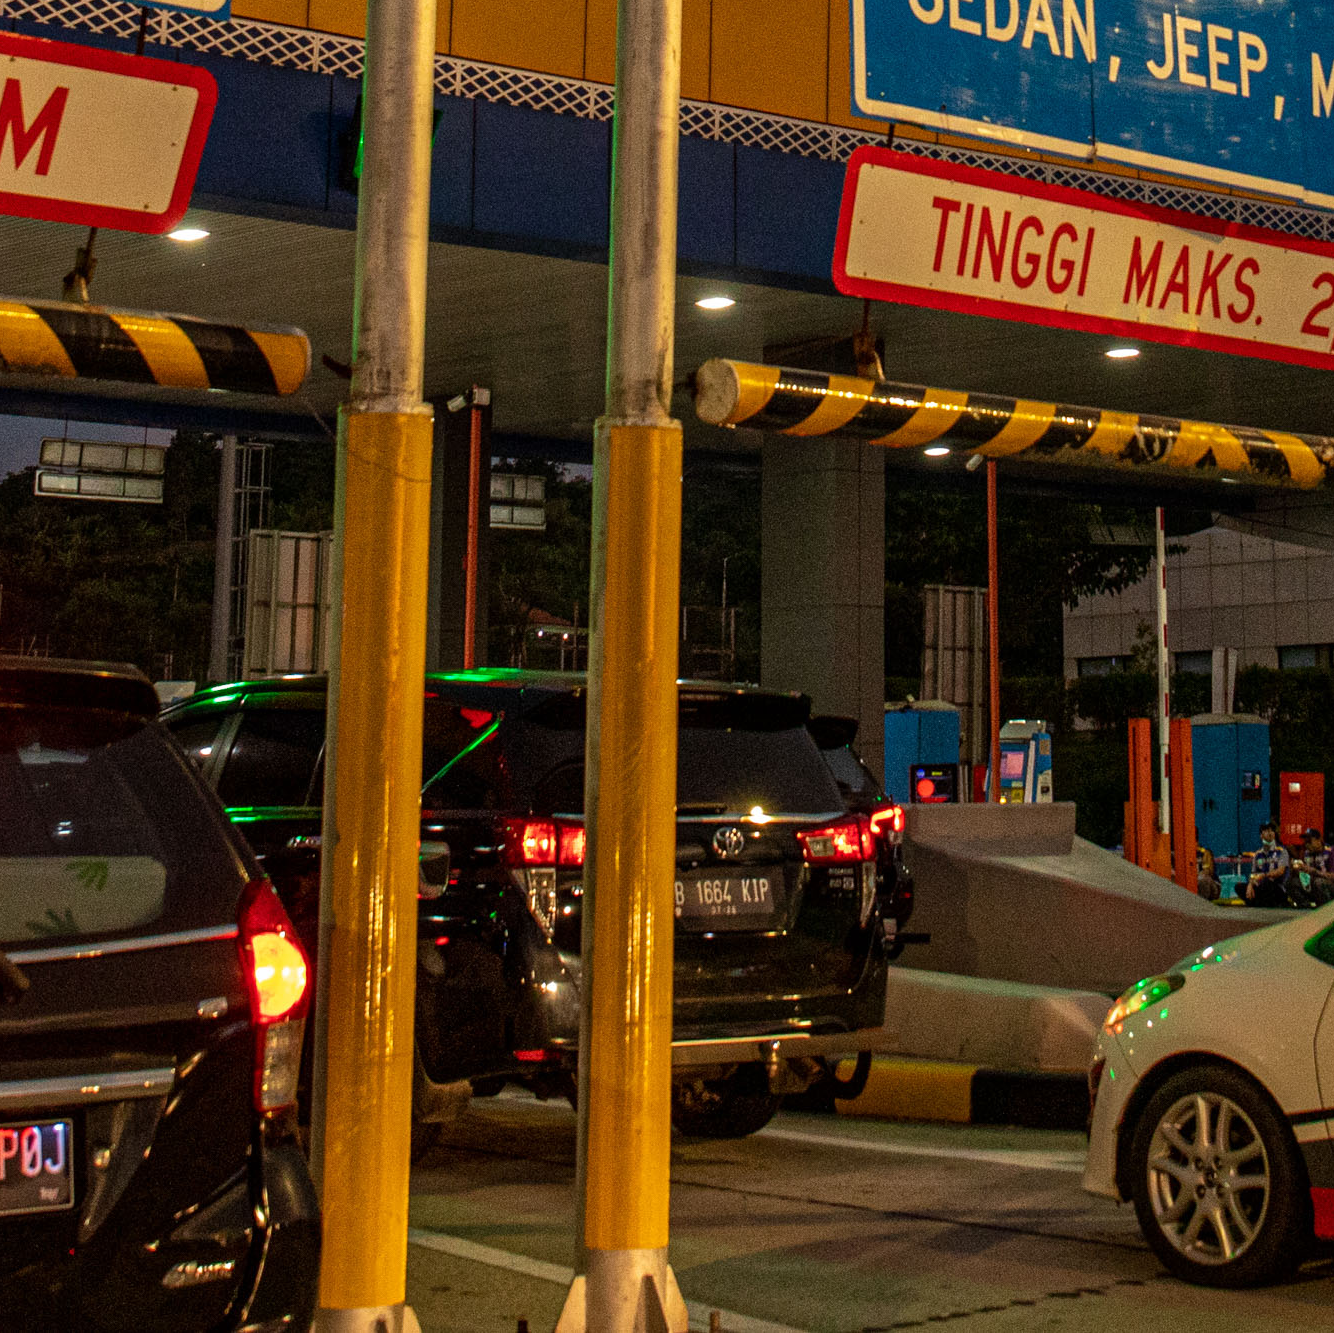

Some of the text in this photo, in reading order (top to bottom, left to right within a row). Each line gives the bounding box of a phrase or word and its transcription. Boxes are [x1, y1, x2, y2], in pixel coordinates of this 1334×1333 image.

[1146, 12, 1285, 121] JEEP,
[932, 196, 1093, 297] TINGGI
[1123, 235, 1264, 325] MAKS.
[674, 878, 769, 906] B 1664 KIP
